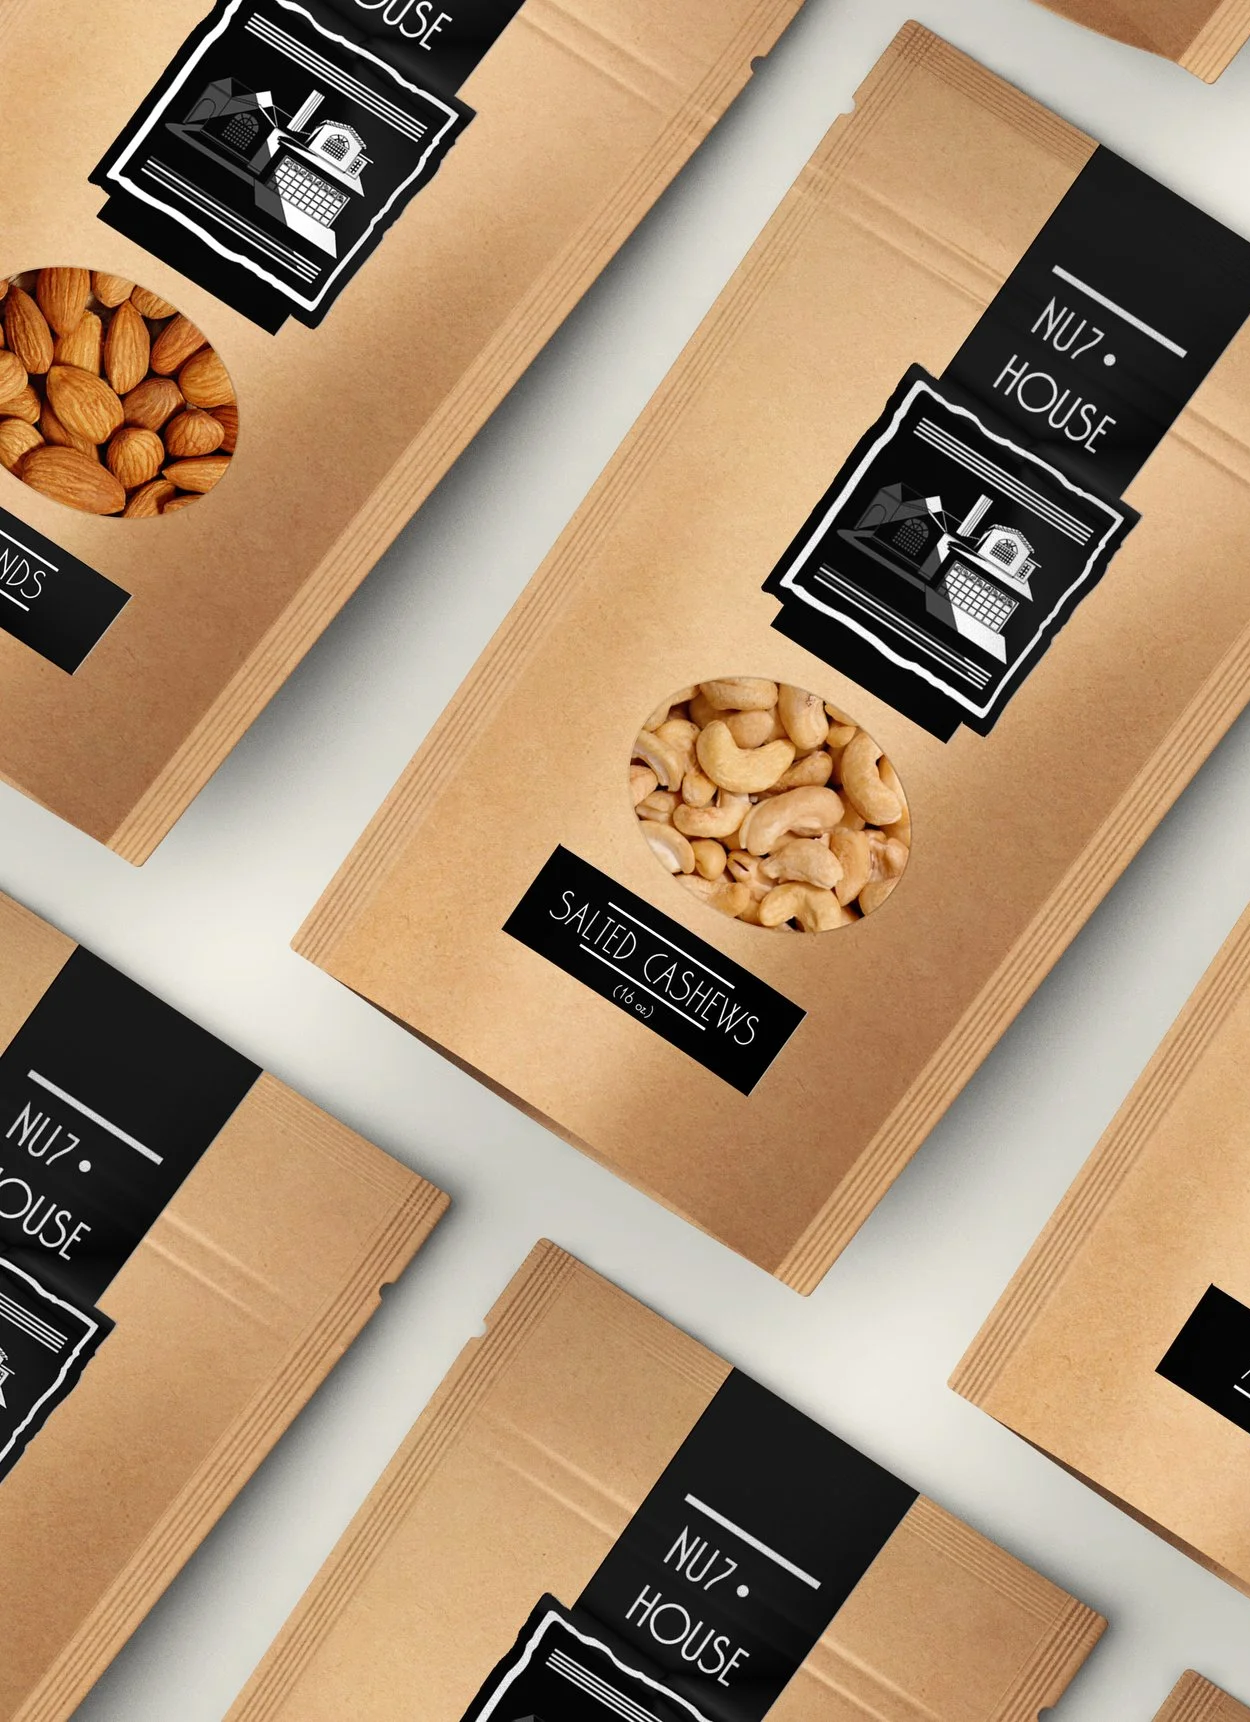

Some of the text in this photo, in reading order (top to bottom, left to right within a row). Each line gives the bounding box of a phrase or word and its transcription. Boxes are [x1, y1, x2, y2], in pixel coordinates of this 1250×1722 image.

[354, 0, 453, 51] USE
[992, 353, 1117, 454] HOUSE
[548, 890, 760, 1046] SALTED CASHEWS
[612, 984, 636, 1005] (16
[0, 1167, 93, 1261] OUSE
[624, 1583, 751, 1687] HOUSE
